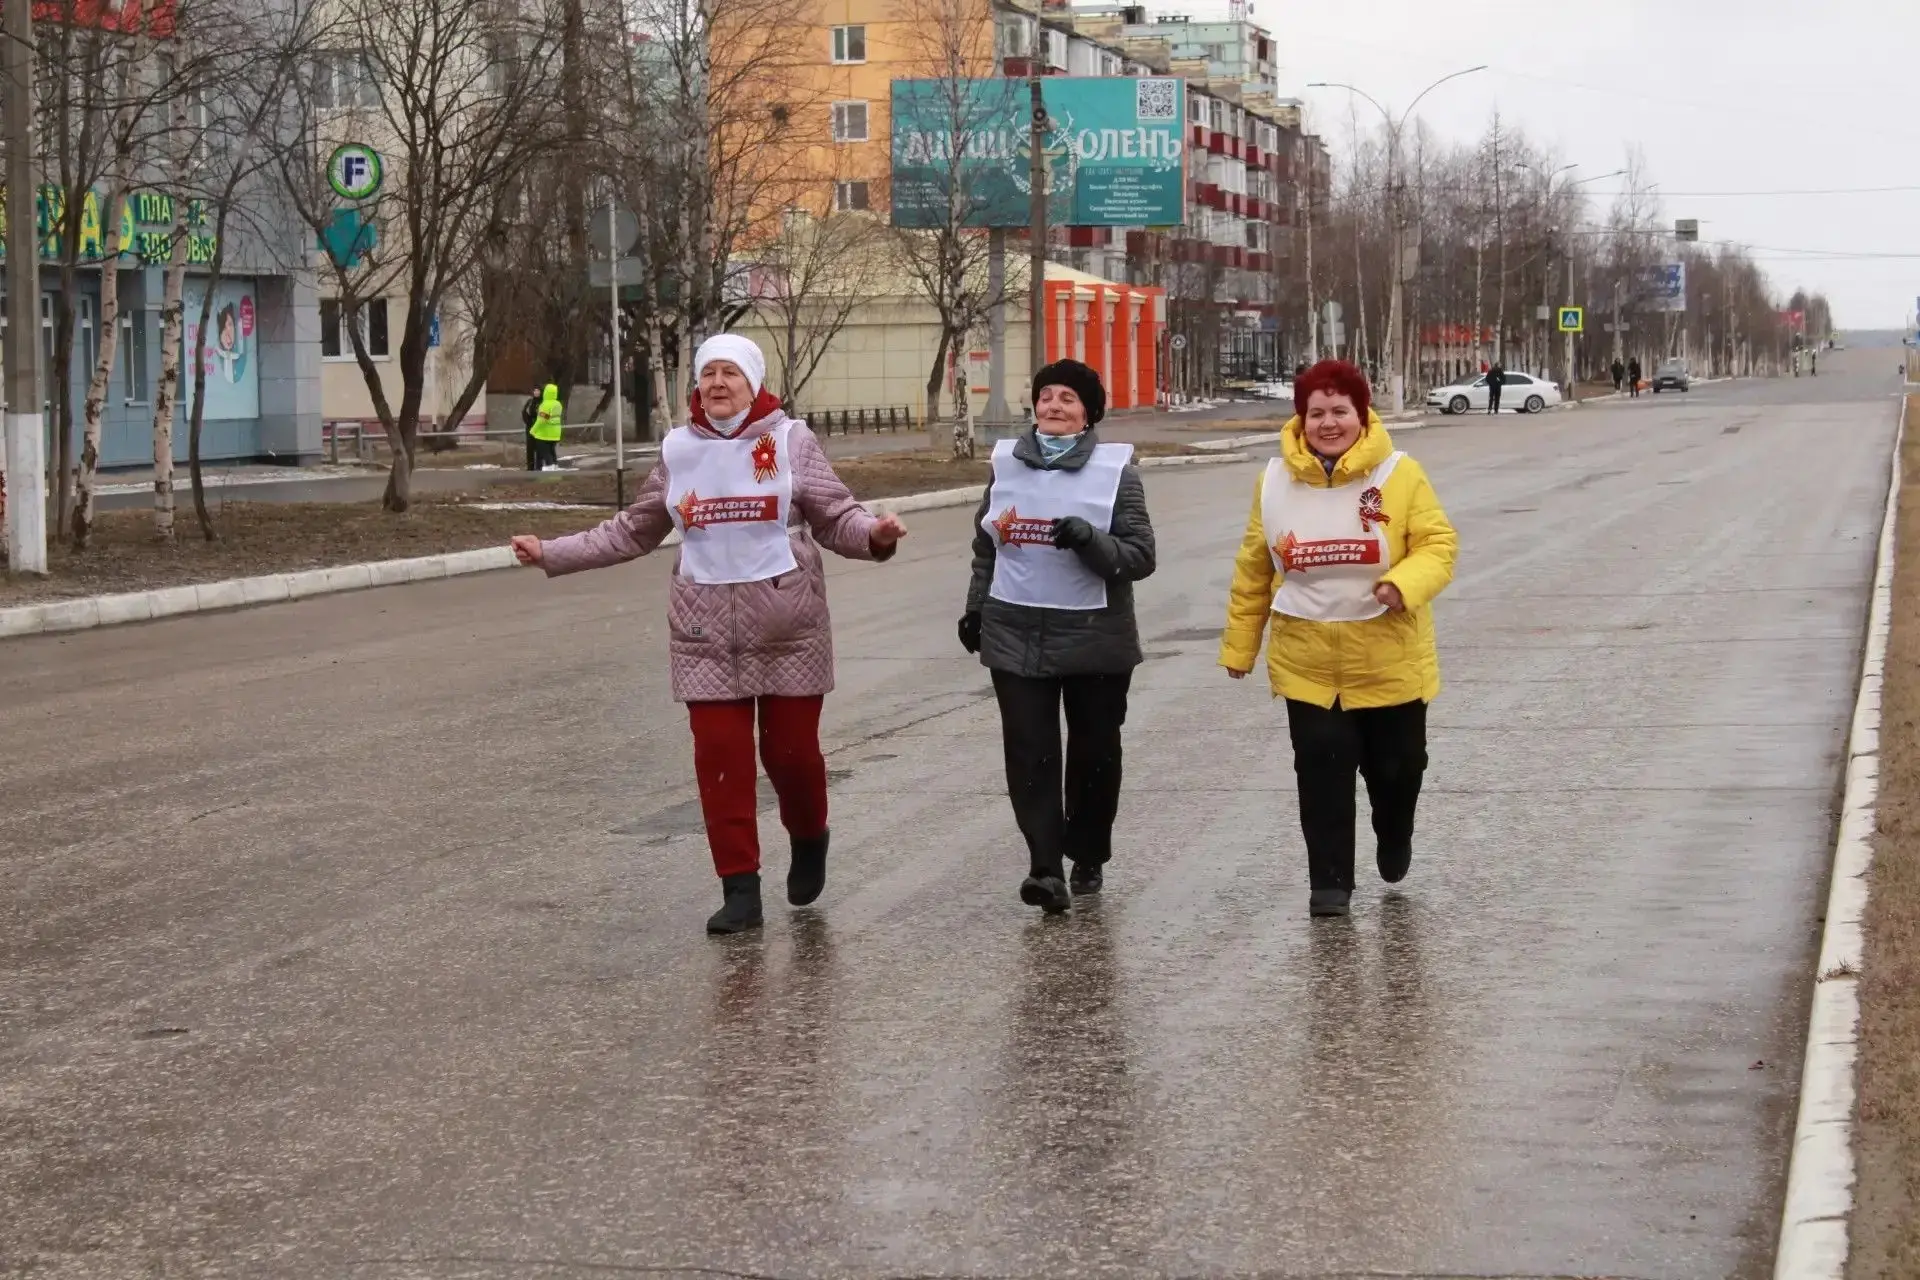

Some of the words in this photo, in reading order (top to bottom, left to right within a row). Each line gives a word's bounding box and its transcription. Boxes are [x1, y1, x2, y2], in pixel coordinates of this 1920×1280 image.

[345, 157, 365, 186] F
[692, 510, 762, 523] ПАМЯТИ
[1006, 522, 1054, 532] ЭСТАФ
[1292, 553, 1361, 565] ПАМЯТИ
